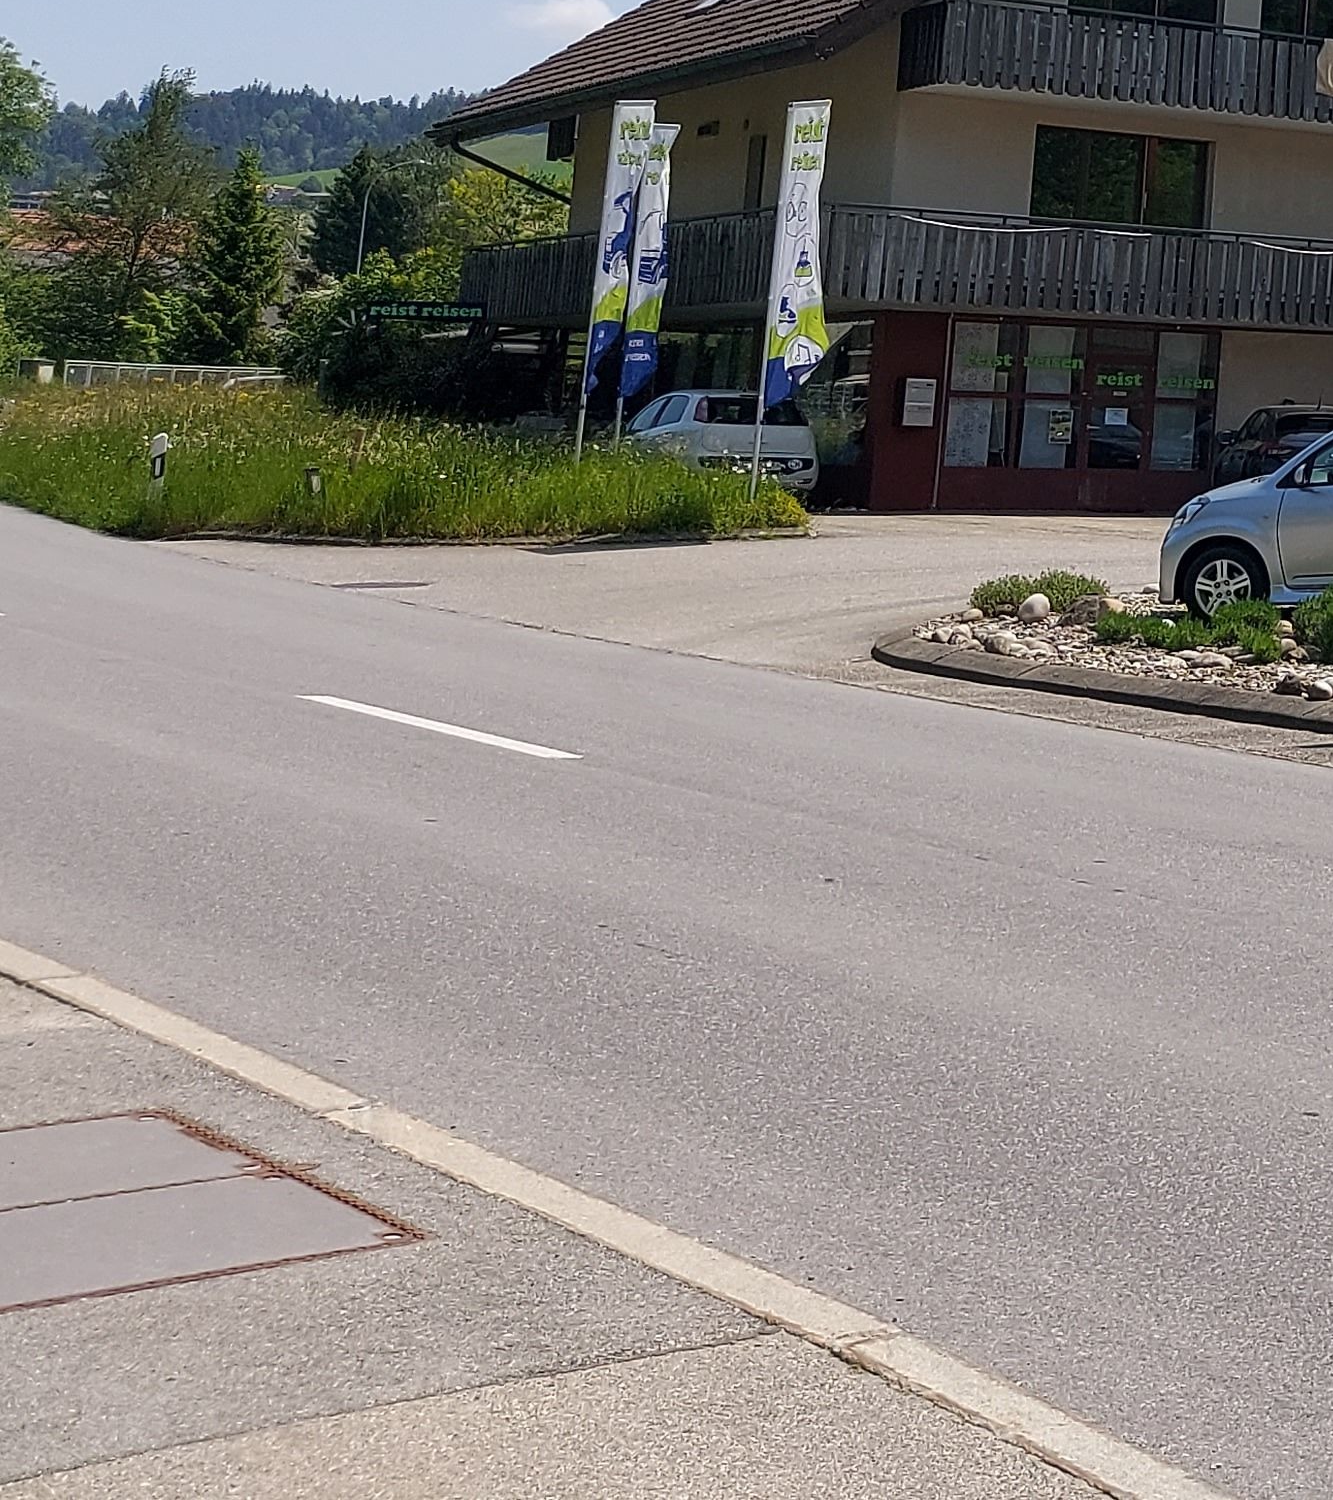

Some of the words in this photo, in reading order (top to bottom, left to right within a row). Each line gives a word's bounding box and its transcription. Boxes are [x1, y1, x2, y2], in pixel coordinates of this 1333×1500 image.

[370, 303, 417, 316] reist
[422, 305, 483, 318] reisen
[1096, 371, 1143, 387] reist
[1158, 375, 1216, 390] reisen
